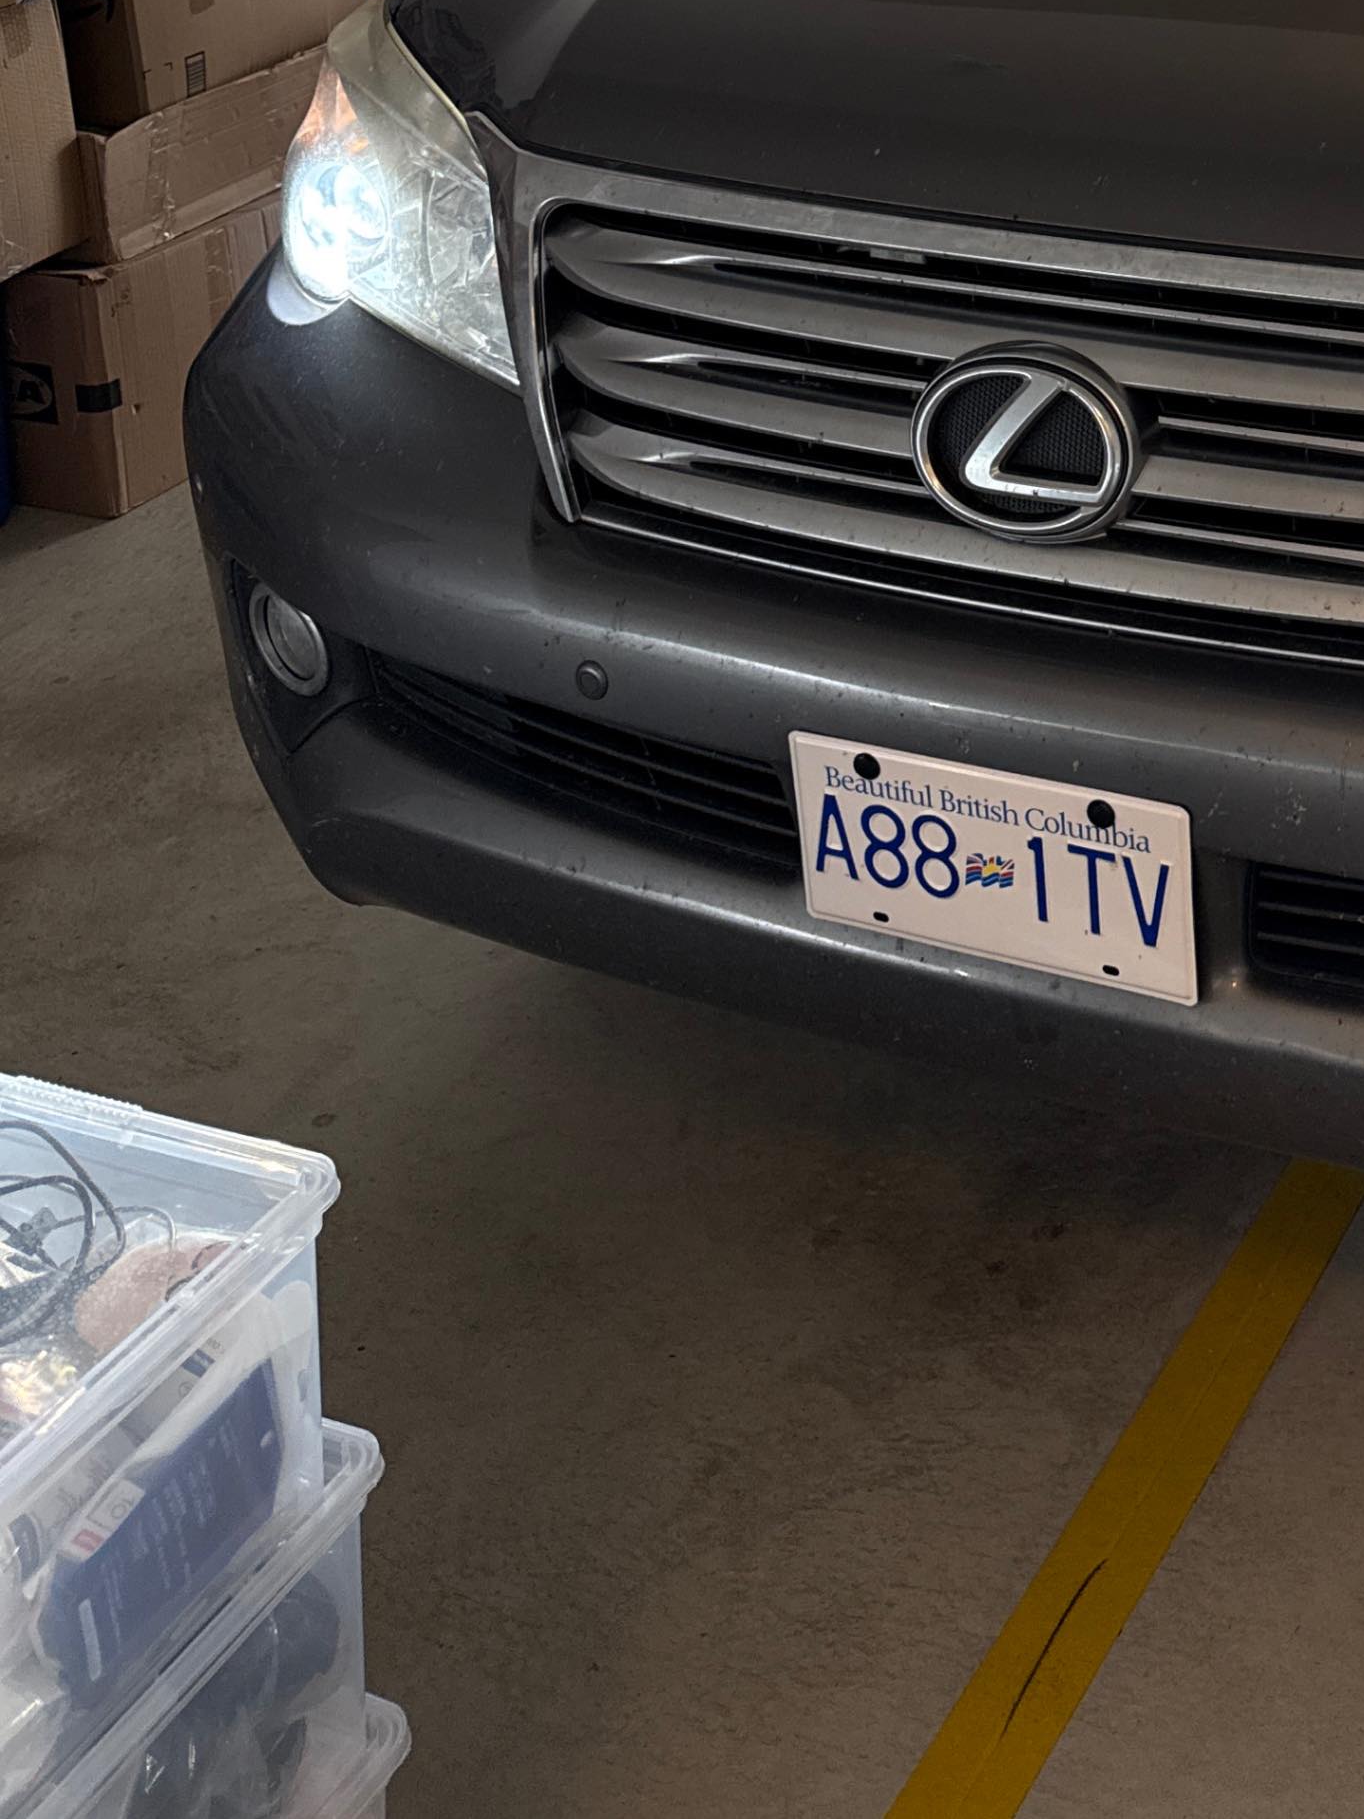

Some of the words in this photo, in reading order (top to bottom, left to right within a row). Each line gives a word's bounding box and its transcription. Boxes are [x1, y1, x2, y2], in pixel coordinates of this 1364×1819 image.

[815, 793, 961, 899] A88
[1026, 836, 1170, 948] 1TV
[824, 765, 933, 809] Beautiful
[939, 788, 1019, 827] British
[1025, 807, 1151, 854] Columbia
